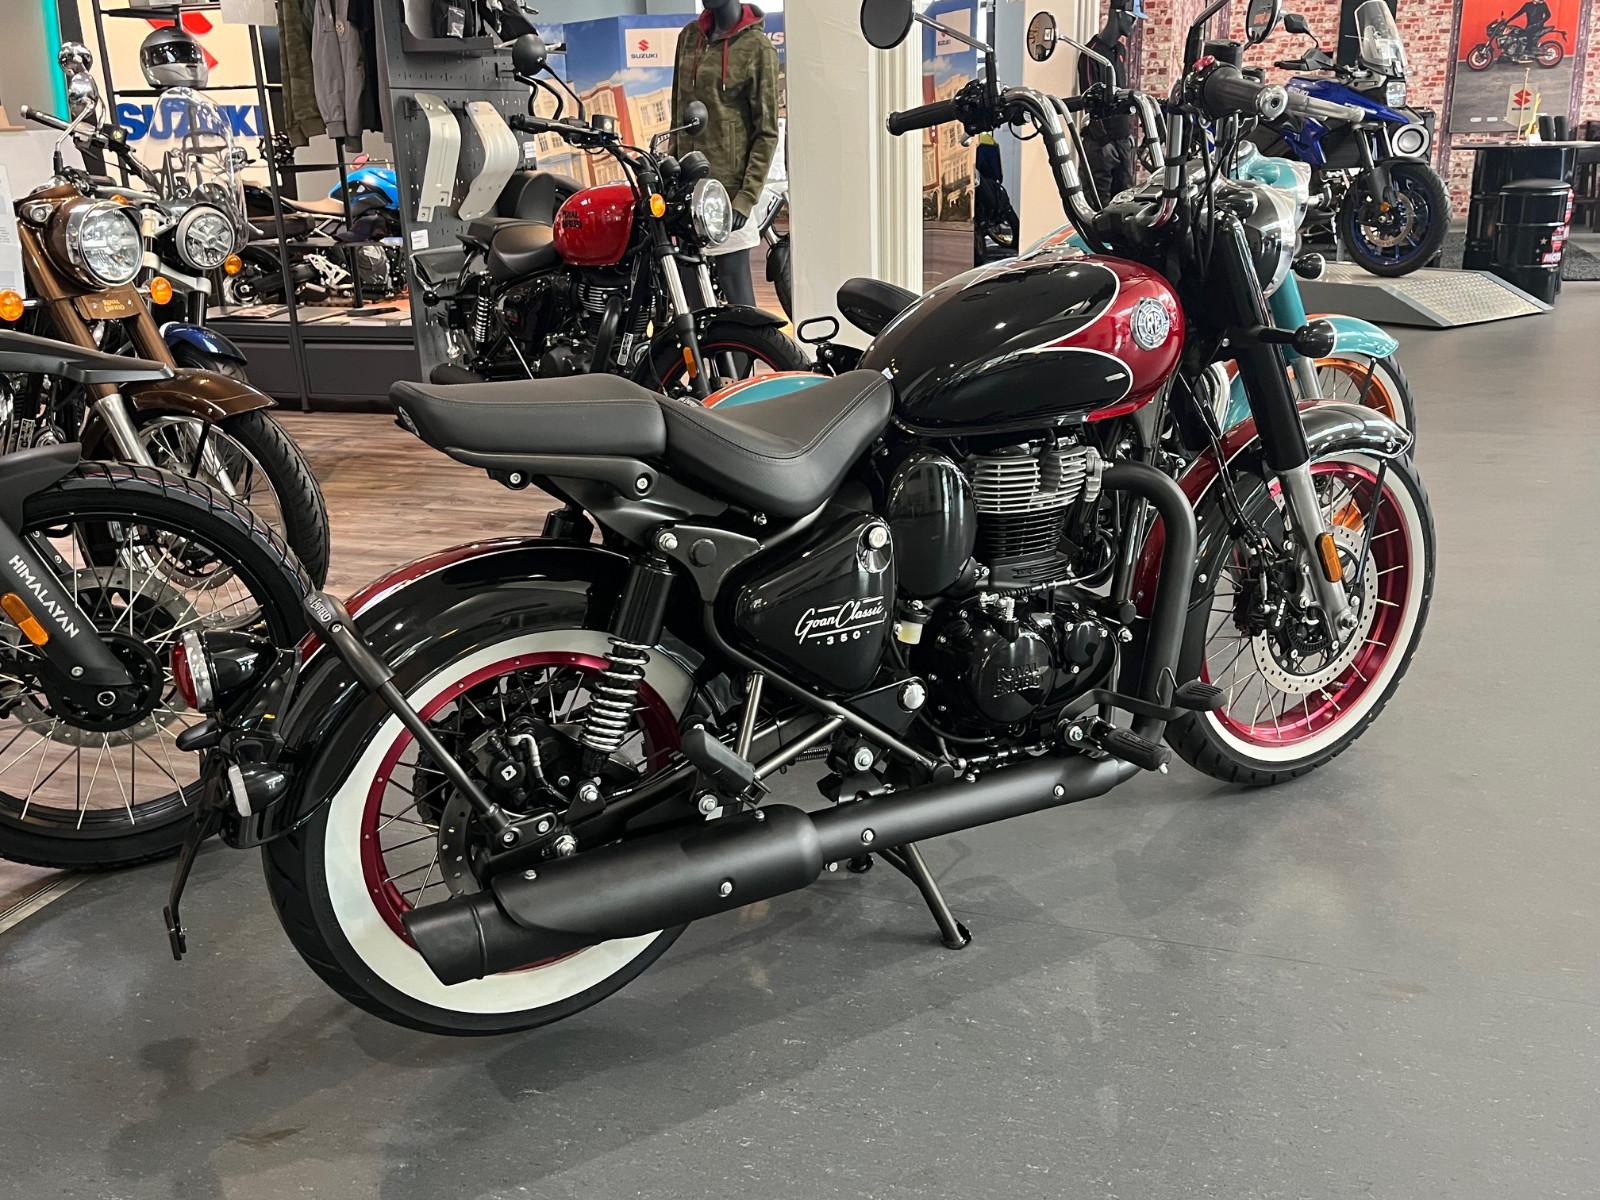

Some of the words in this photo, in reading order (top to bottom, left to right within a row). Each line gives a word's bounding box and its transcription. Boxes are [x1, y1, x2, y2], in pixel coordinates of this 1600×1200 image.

[116, 102, 266, 141] SUZUKI
[8, 554, 80, 639] HIMALAYAN
[794, 607, 837, 645] Goan
[835, 600, 885, 628] Classic
[826, 630, 861, 645] 350
